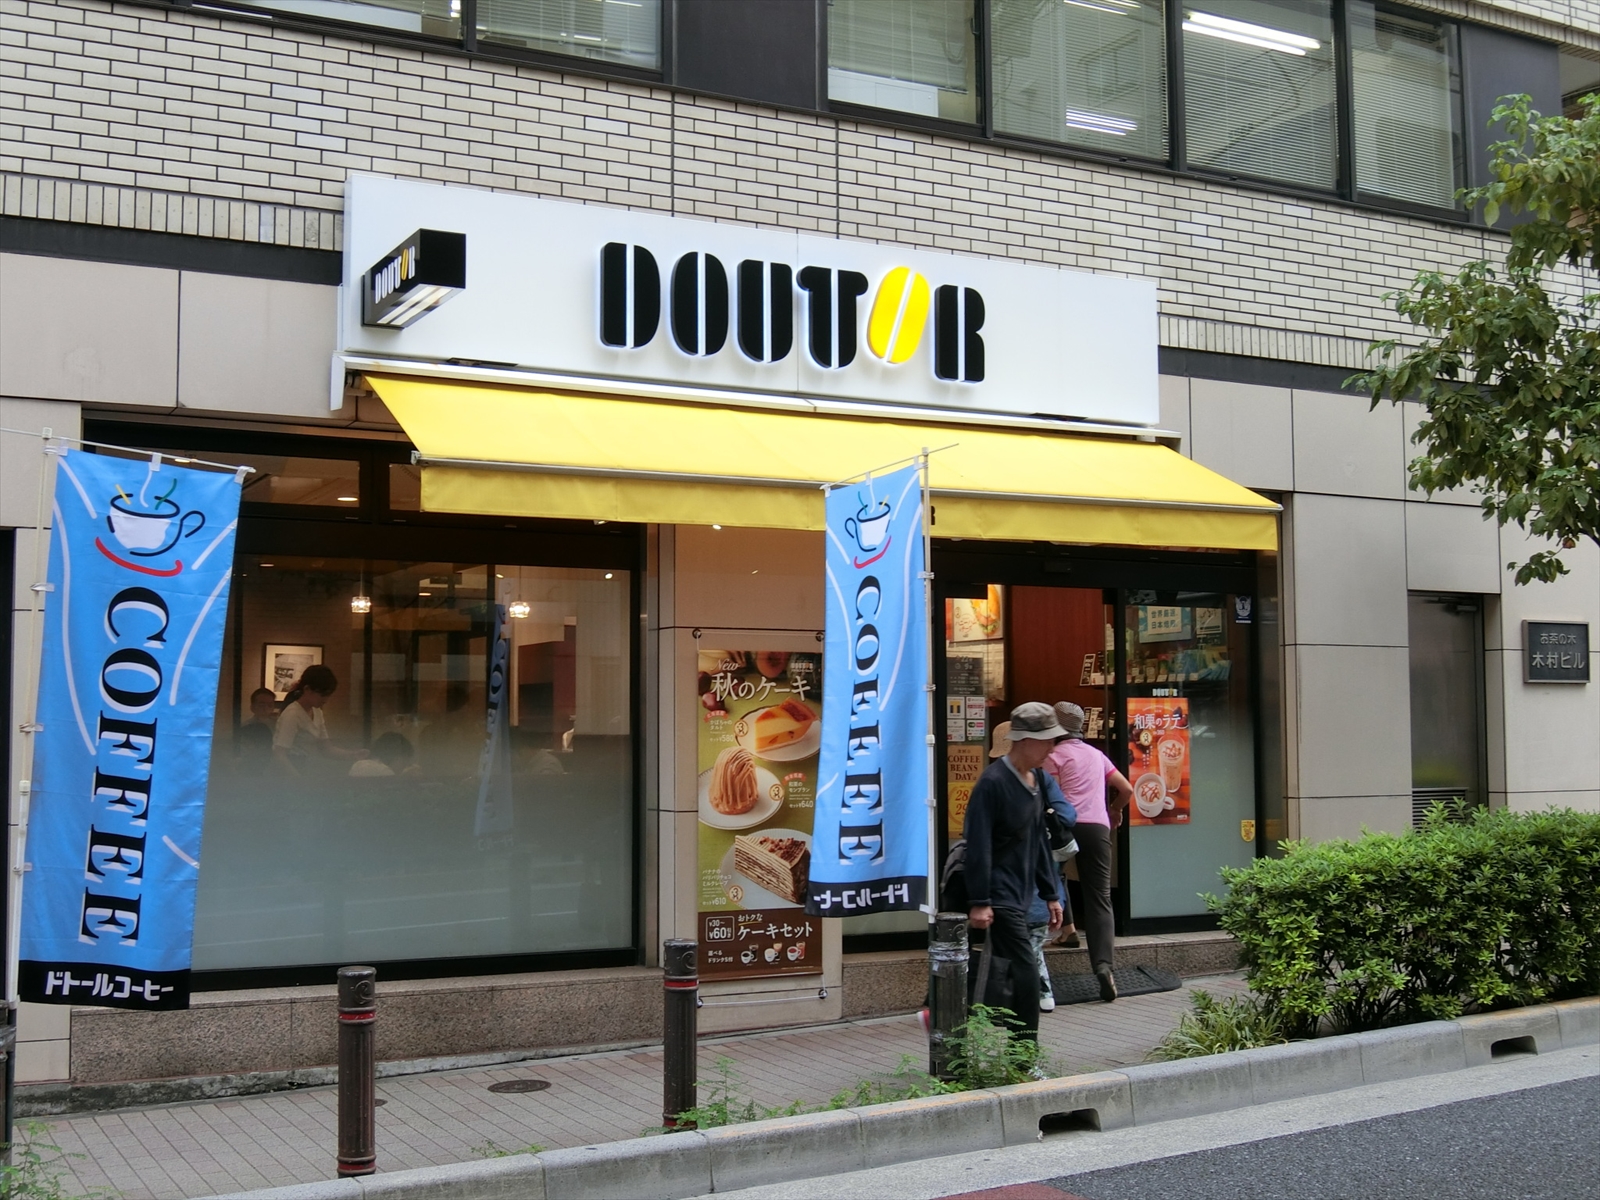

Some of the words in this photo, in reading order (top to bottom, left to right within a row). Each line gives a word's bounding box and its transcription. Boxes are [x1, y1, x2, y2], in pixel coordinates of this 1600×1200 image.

[375, 245, 416, 304] DOUTOR
[601, 242, 985, 382] DOUTOR
[711, 658, 740, 671] New
[1531, 651, 1585, 669] 木村ビル
[711, 672, 811, 702] 秋のケーキ
[1134, 713, 1182, 730] 和栗のラテ
[79, 586, 170, 947] COFFEE
[948, 755, 981, 763] COFFEE
[950, 763, 978, 772] BEANS
[955, 773, 973, 781] DAY
[955, 789, 969, 801] 28
[737, 913, 763, 922] おトクな
[737, 921, 813, 941] ケーキセット
[45, 970, 174, 1002] ドトールコーヒー
